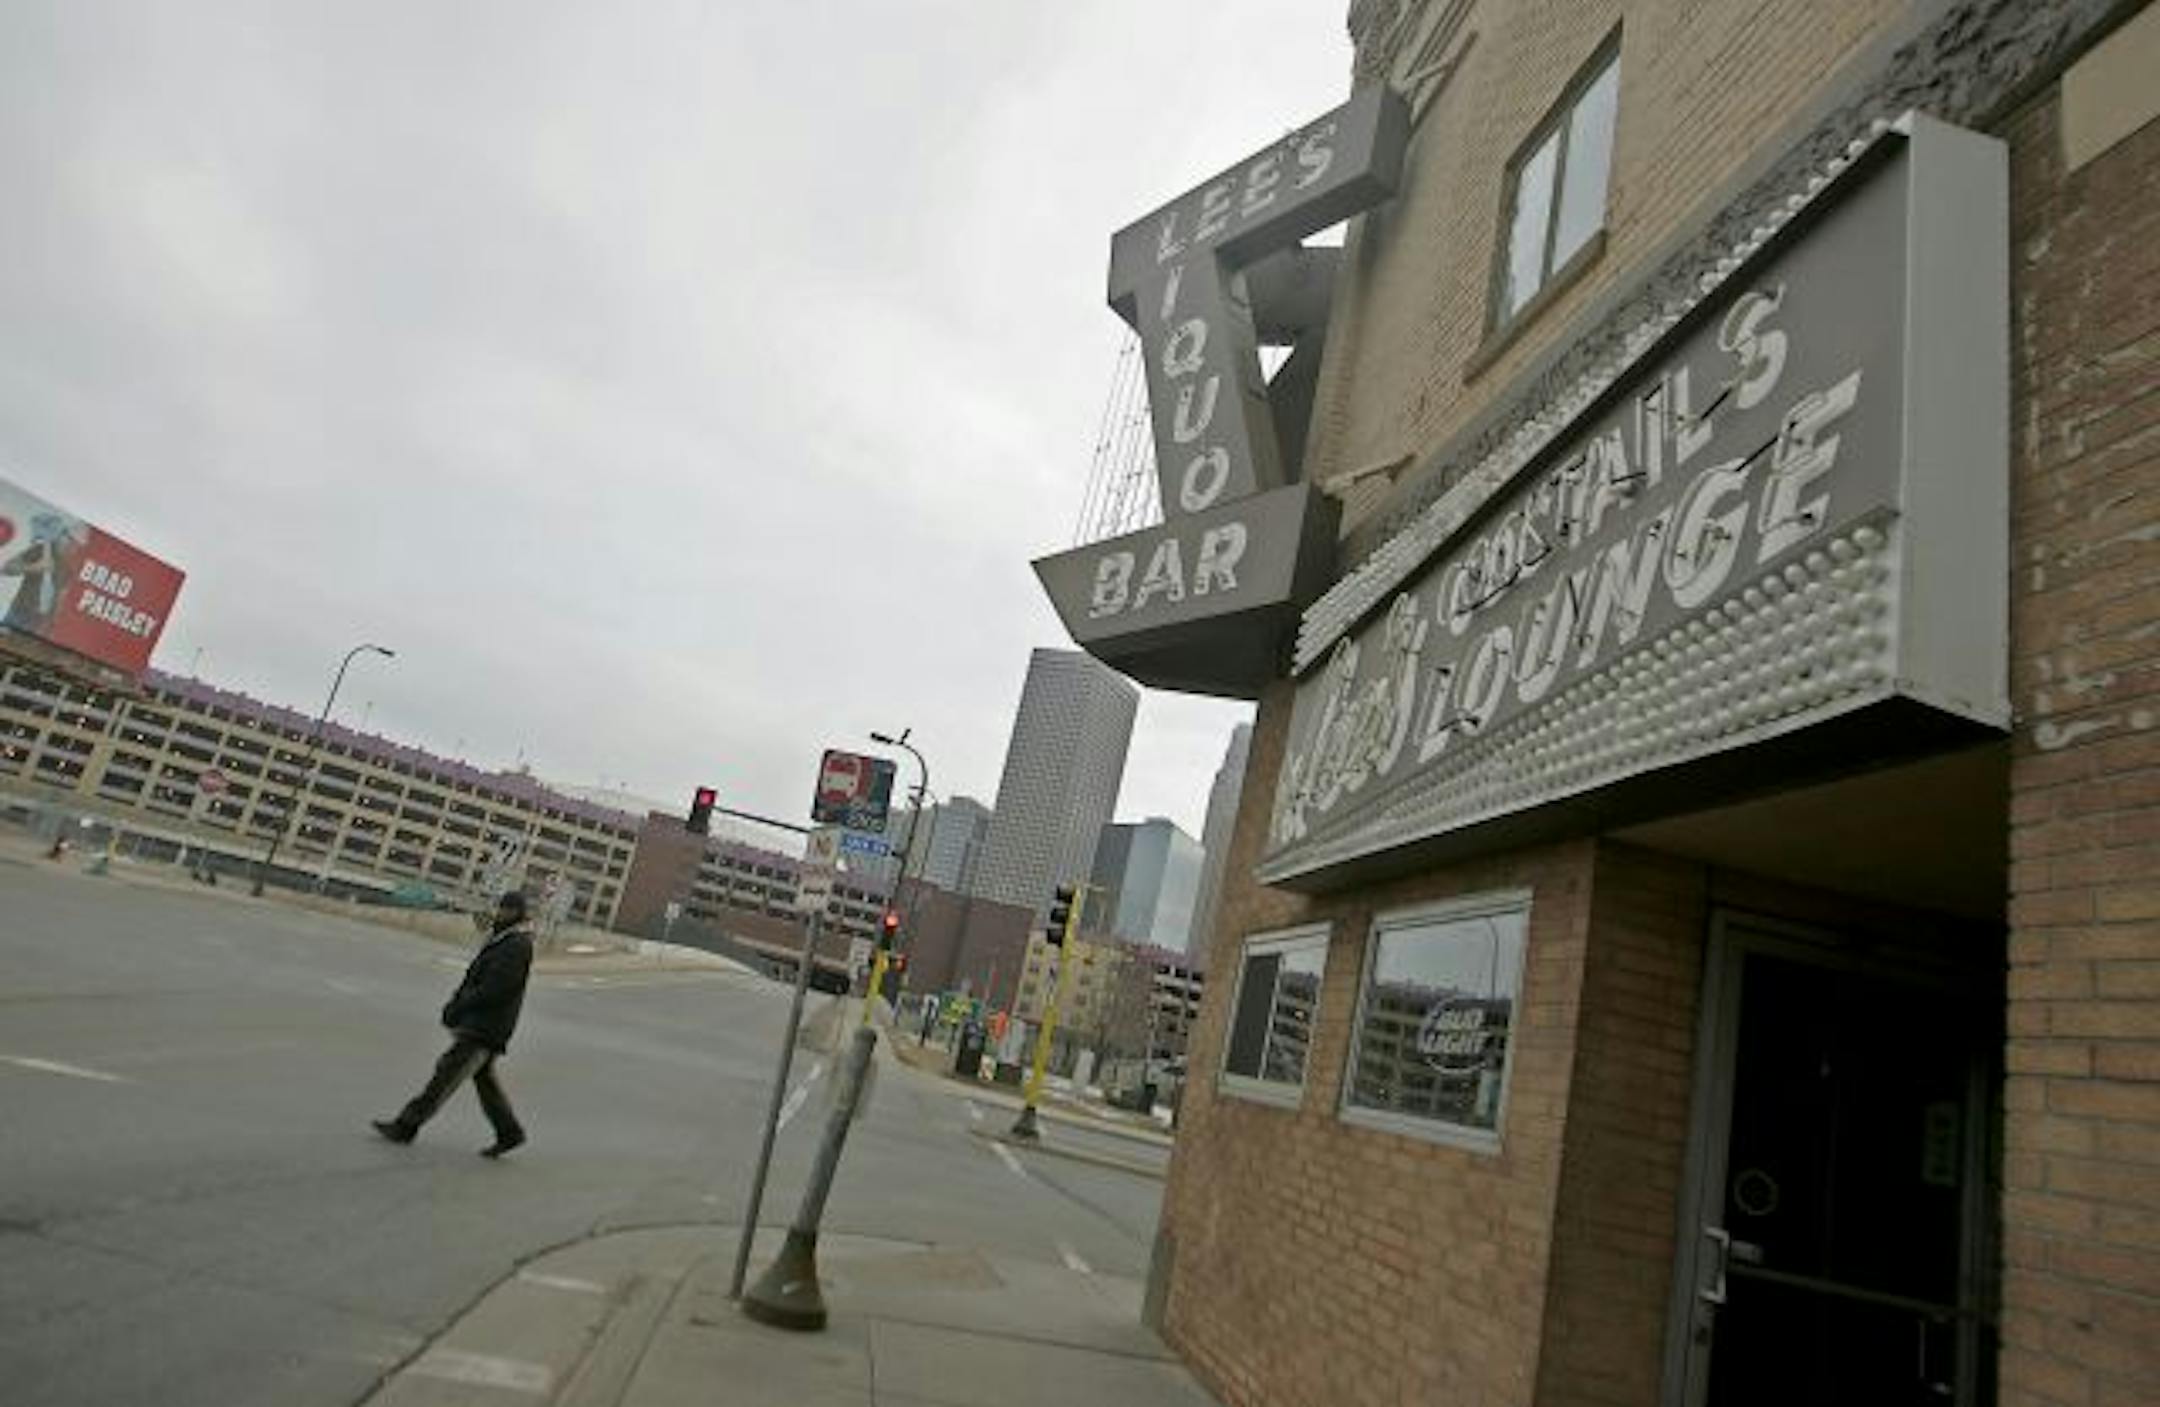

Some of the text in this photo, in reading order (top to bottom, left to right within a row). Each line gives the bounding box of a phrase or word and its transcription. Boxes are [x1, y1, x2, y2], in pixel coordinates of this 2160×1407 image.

[81, 561, 133, 598] BRAD
[1089, 521, 1247, 619] BAR
[1414, 370, 1863, 763] LOUNGE
[78, 590, 156, 636] PAISLEY
